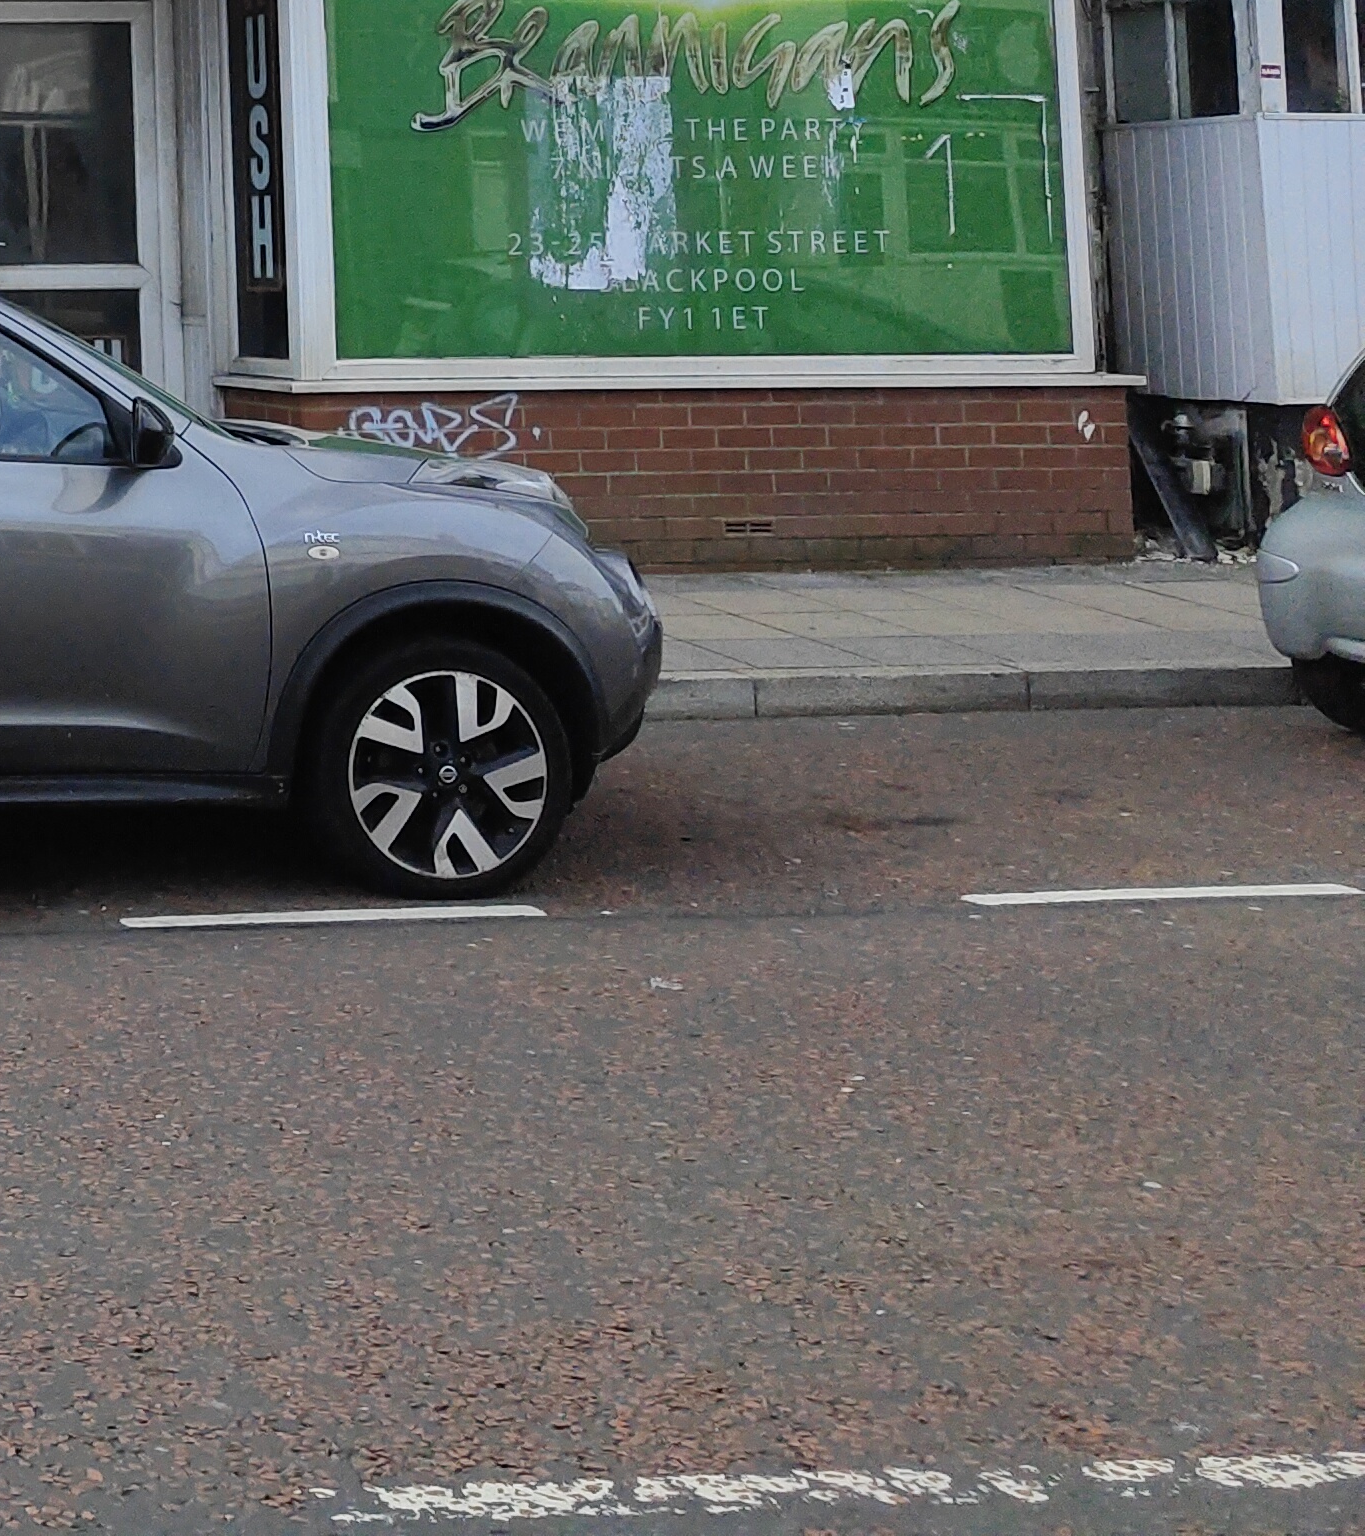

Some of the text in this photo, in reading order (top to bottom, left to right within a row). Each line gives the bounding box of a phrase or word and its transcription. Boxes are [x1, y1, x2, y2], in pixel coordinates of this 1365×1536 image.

[684, 119, 749, 142] THE
[762, 118, 865, 141] PARTY
[579, 155, 707, 181] NITS
[719, 155, 738, 180] A
[647, 230, 755, 256] ARKET
[767, 230, 891, 255] STREET
[638, 306, 770, 330] FY1 1ET
